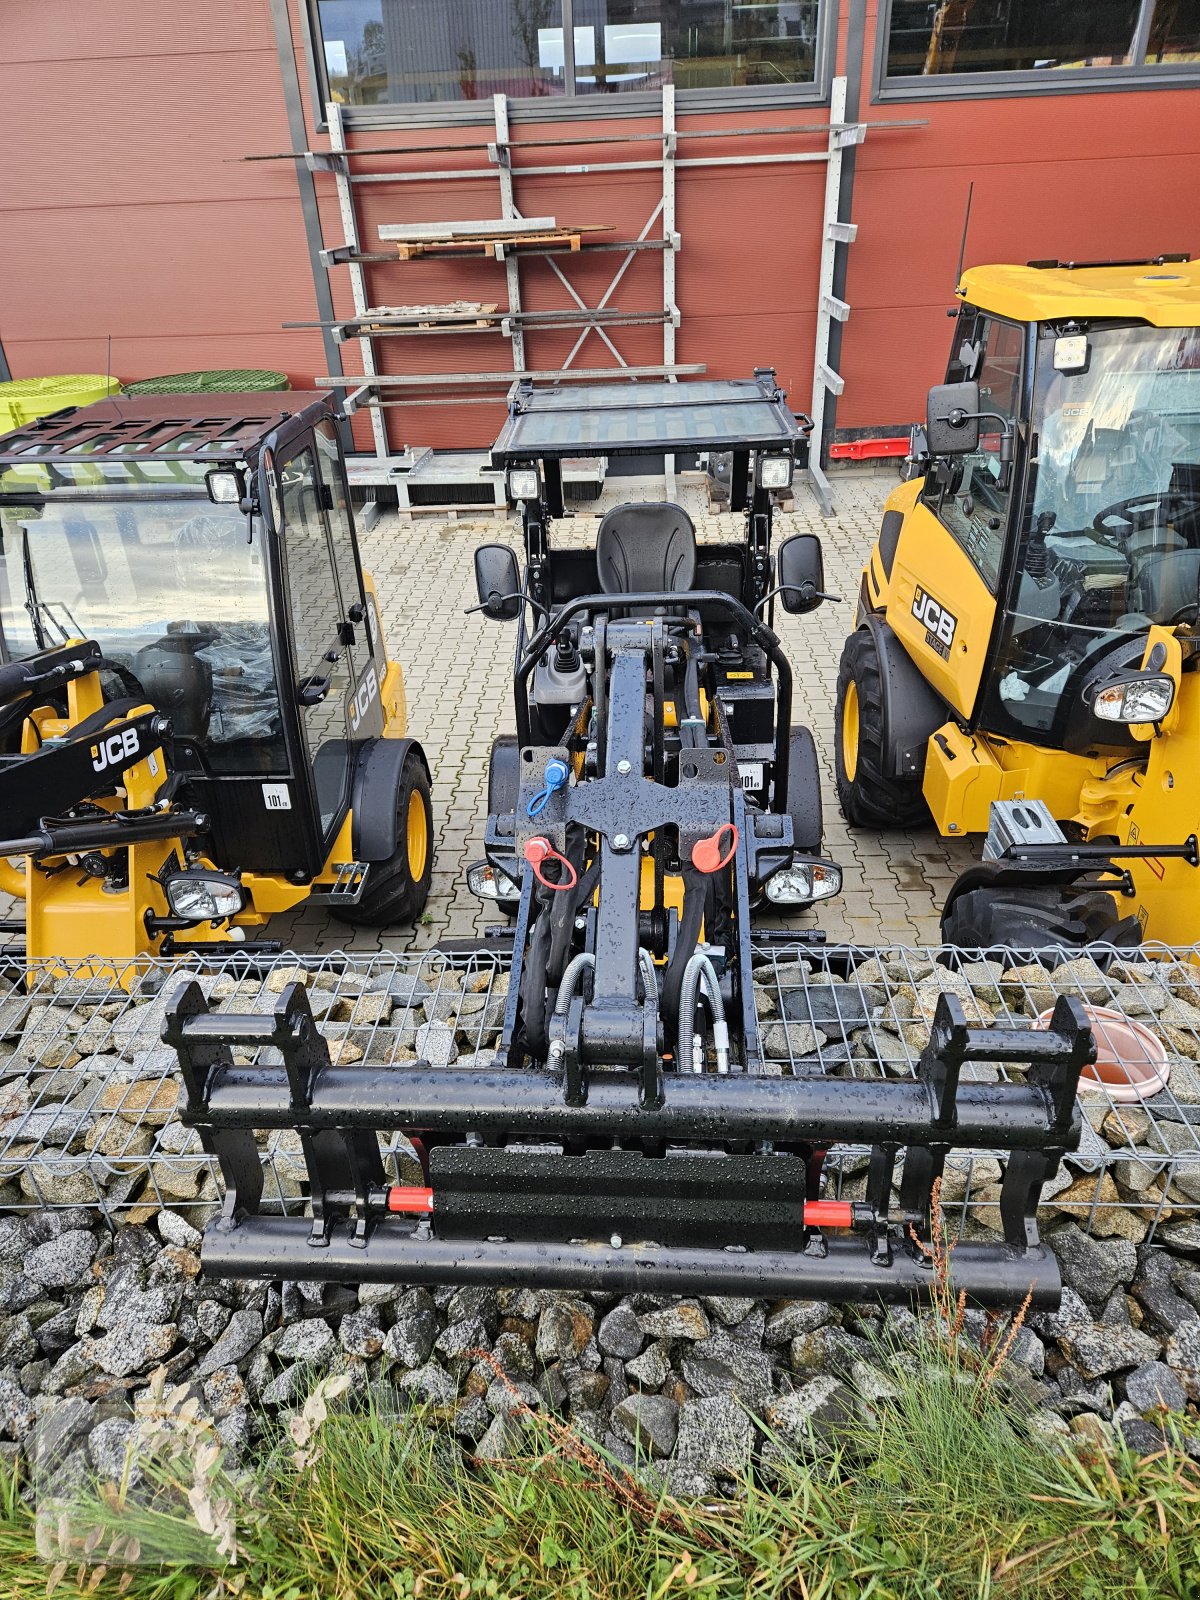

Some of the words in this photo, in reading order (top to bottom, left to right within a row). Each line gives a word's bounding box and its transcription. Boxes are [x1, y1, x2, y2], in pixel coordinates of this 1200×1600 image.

[913, 593, 956, 646] JCB
[926, 633, 944, 656] STAGE
[351, 667, 378, 731] JCB
[91, 727, 140, 772] JCB
[740, 775, 754, 788] 101
[267, 794, 282, 807] 101
